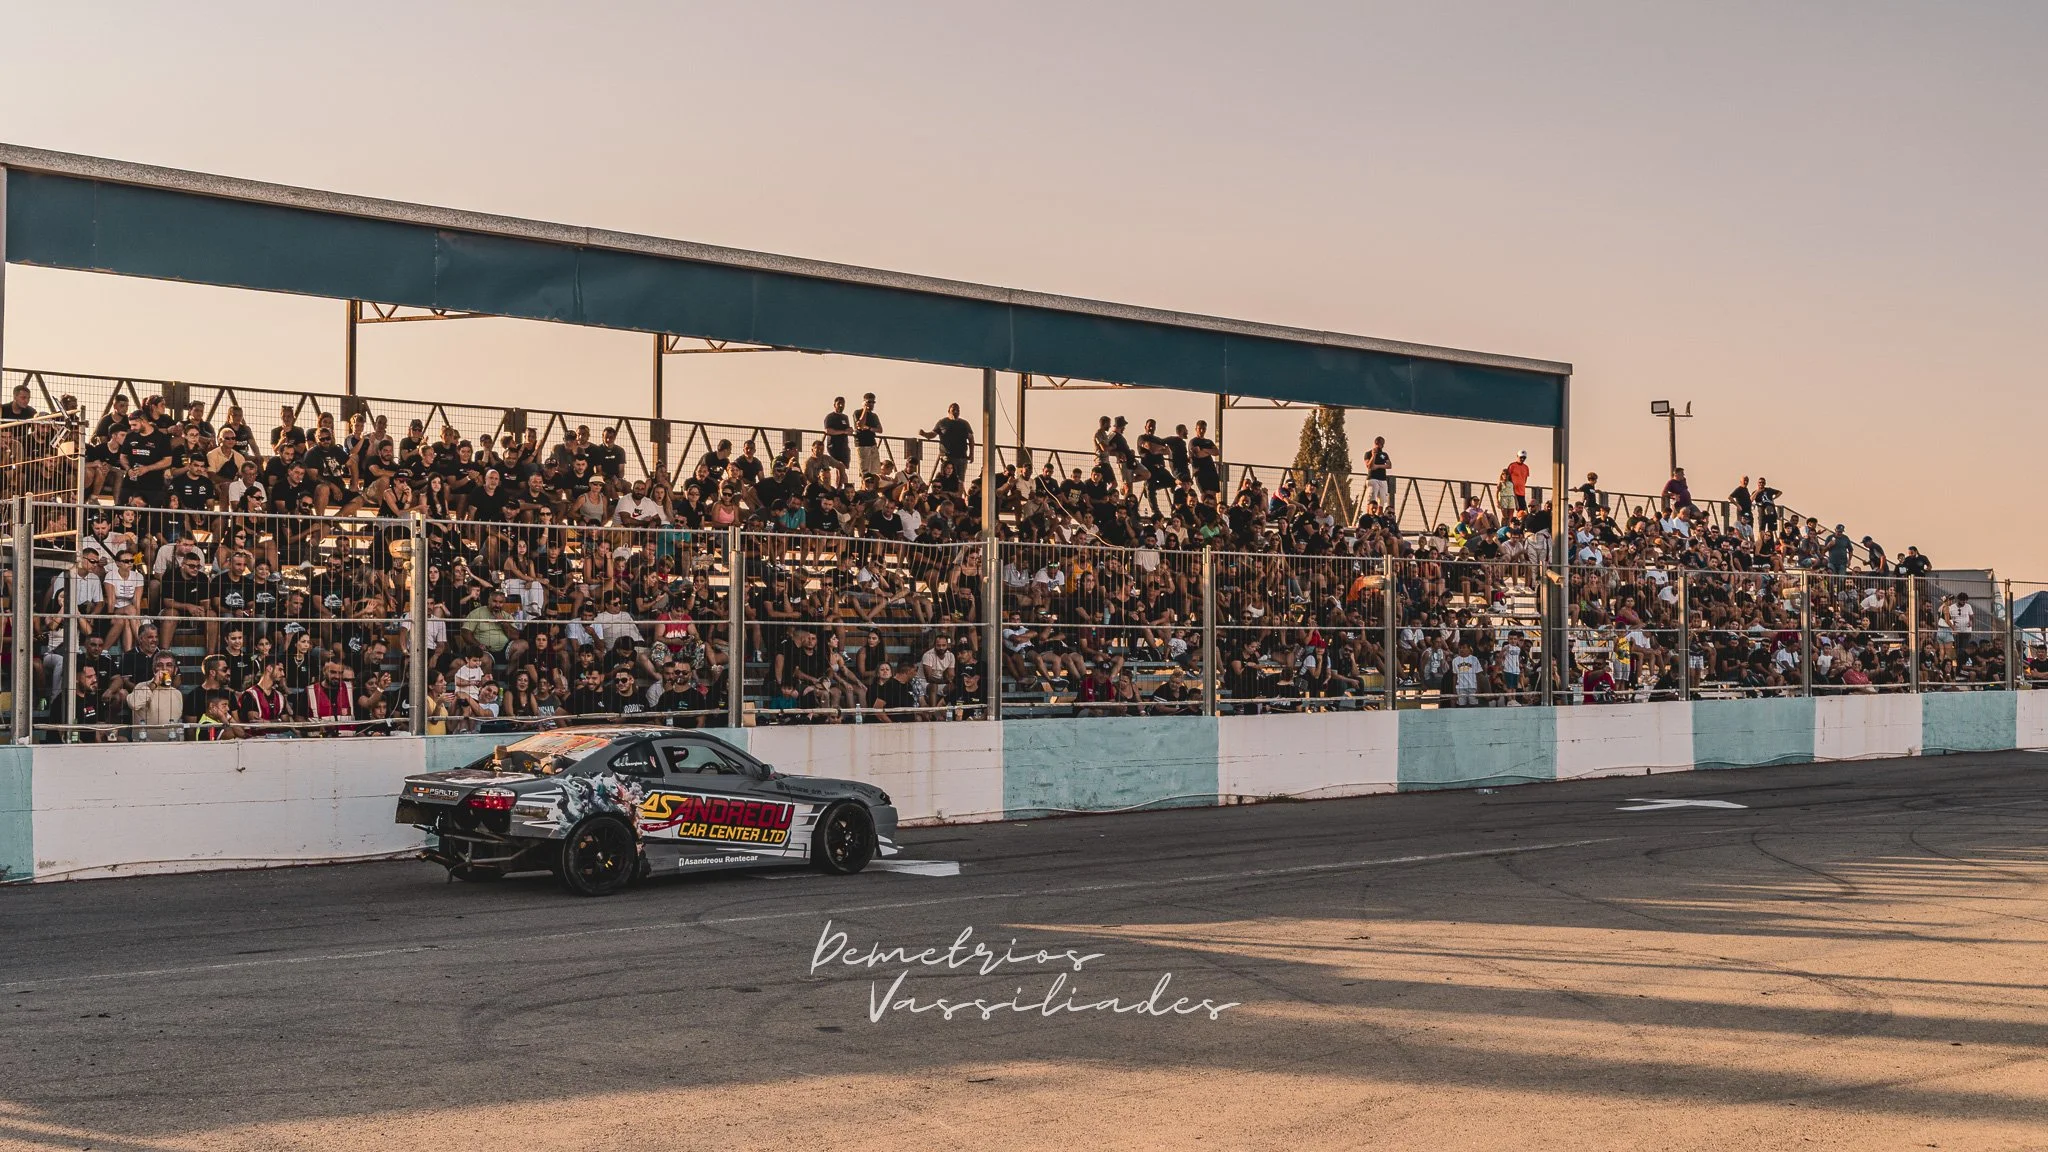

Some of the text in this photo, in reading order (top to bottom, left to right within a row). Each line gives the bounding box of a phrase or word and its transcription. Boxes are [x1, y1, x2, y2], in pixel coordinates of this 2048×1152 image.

[429, 788, 459, 797] PSALTIS
[679, 822, 706, 837] CAR
[709, 824, 760, 841] CENTER
[761, 828, 786, 843] LTD
[684, 855, 759, 866] Asandreou Rentecar
